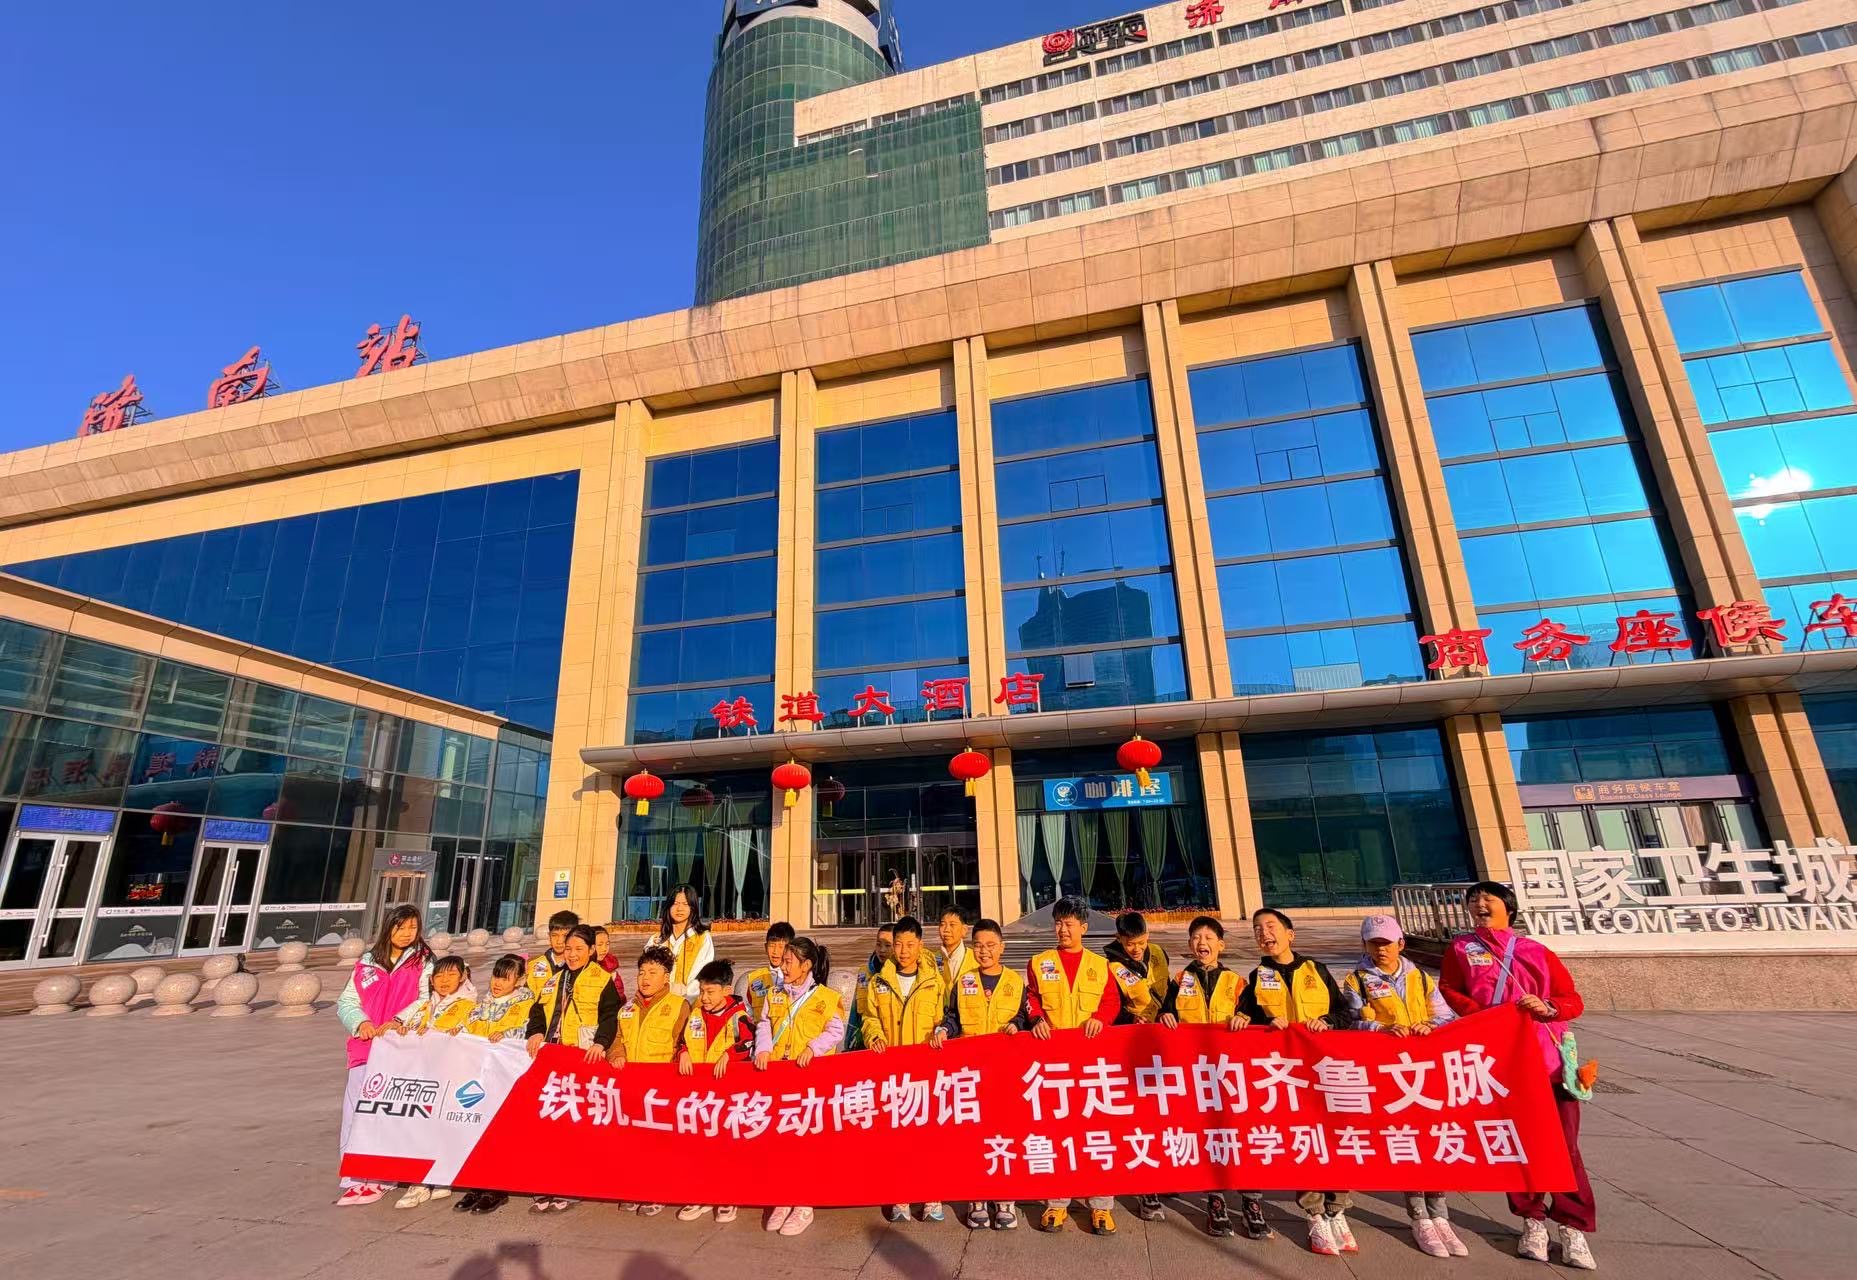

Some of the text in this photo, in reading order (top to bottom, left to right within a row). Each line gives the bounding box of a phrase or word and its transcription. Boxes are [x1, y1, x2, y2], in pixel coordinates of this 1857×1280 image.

[1418, 592, 1857, 670] 商务座候车
[709, 672, 1045, 727] 铁道大酒店
[1597, 781, 1681, 795] 商务座候车室
[1507, 837, 1857, 909] 国家卫生城
[1522, 904, 1857, 936] WELCOME TO JINAN
[538, 1043, 1510, 1141] 铁轨上的移动博物馆 行走中的齐鲁文脉
[983, 1118, 1530, 1177] 齐鲁1号文物研学列车首发团
